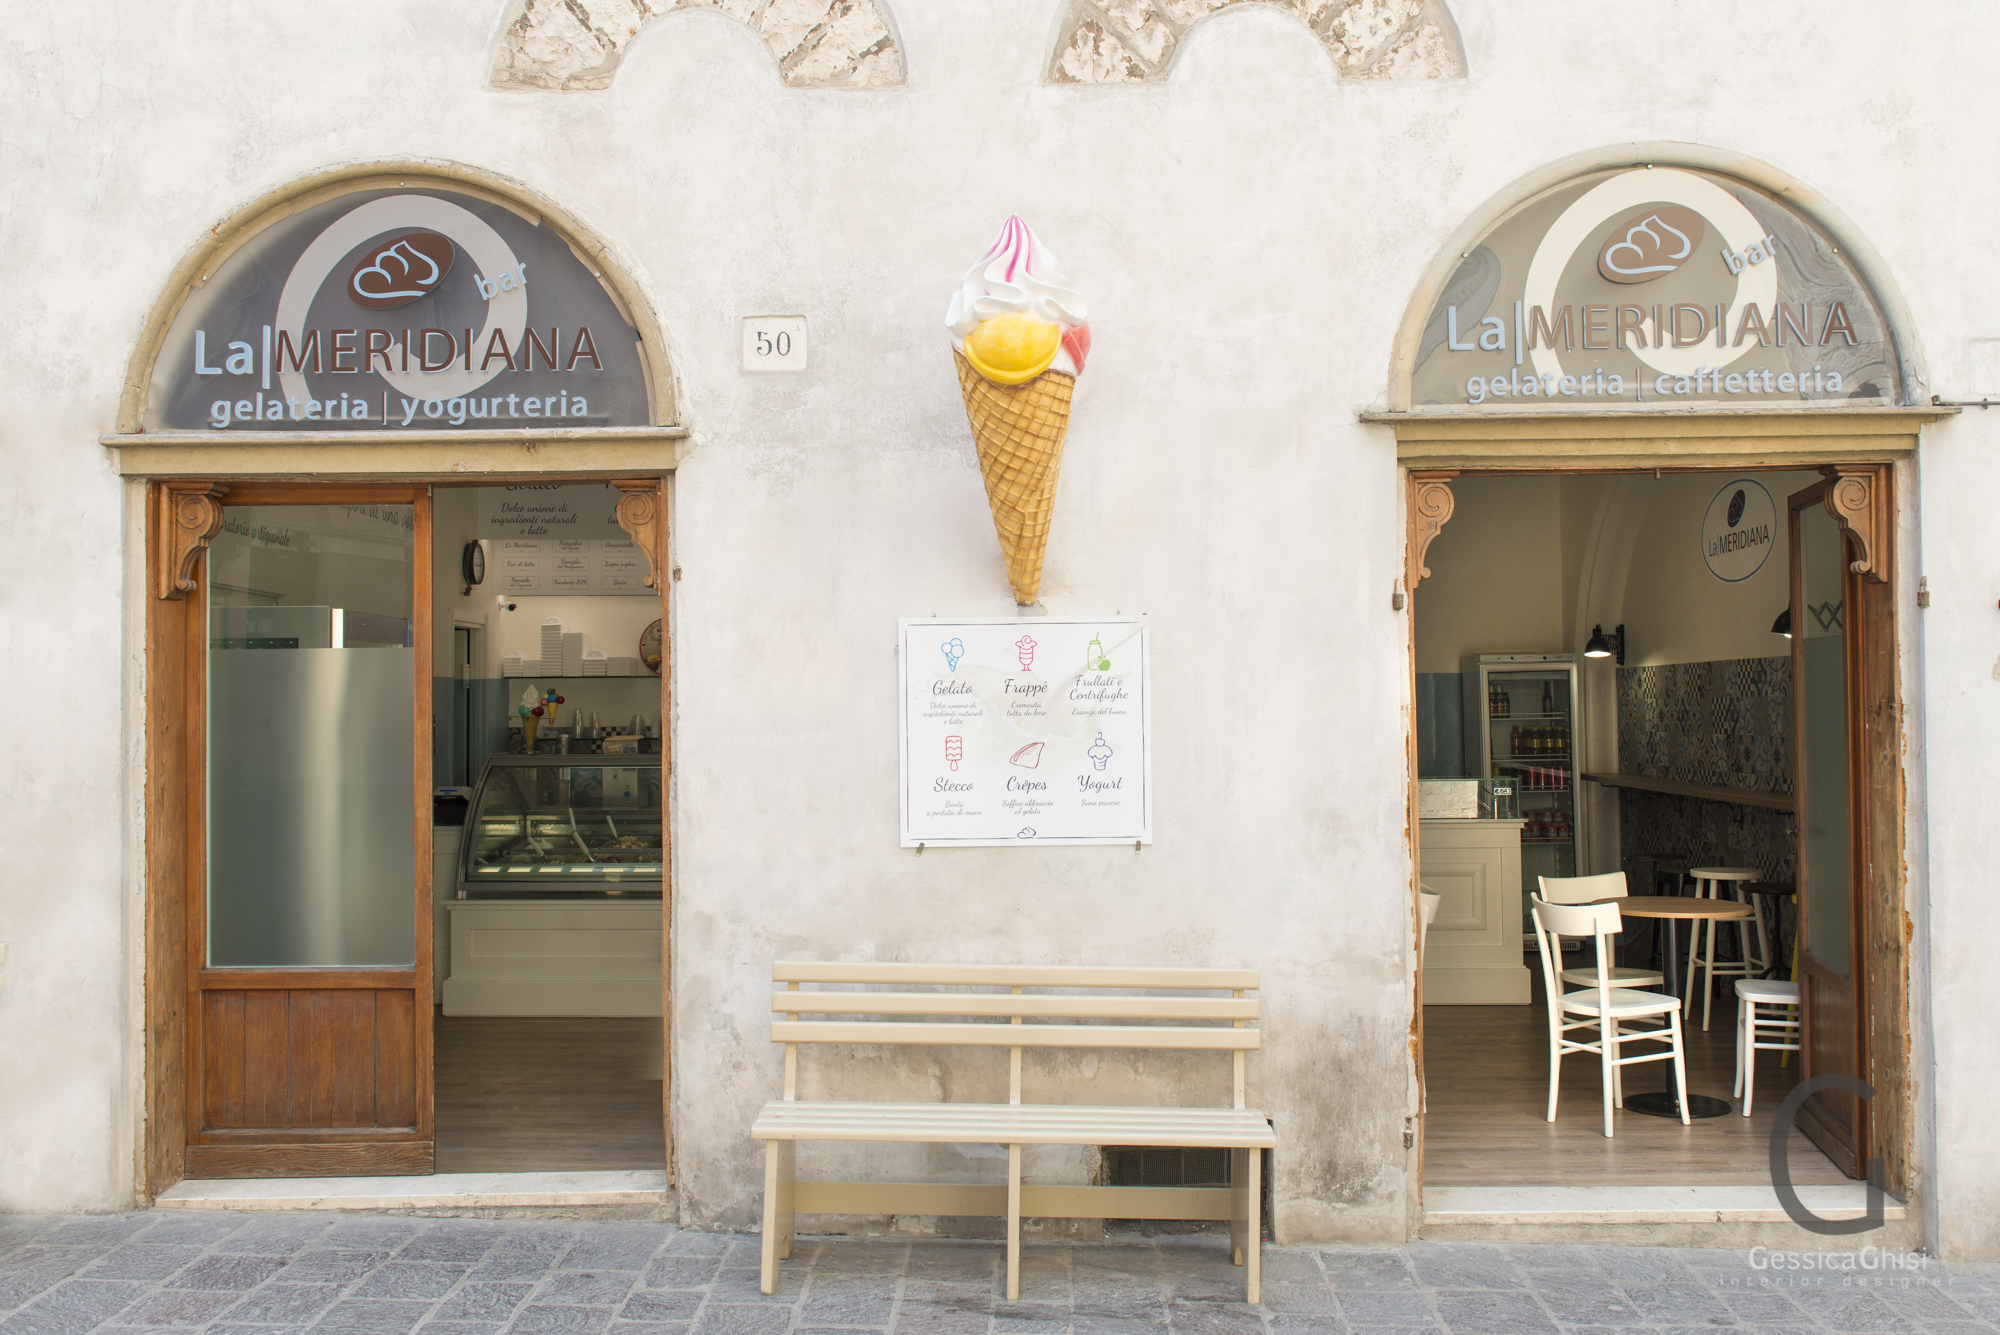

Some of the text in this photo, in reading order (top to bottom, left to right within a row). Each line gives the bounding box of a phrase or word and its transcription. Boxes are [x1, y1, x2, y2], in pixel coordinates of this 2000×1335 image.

[1720, 233, 1778, 276] bar
[473, 262, 527, 300] bar
[1447, 301, 1858, 351] La MERIDIANA
[195, 326, 603, 375] La MERIDIANA
[756, 331, 791, 356] 50
[1466, 364, 1843, 403] gelateria caffetteria
[211, 390, 589, 428] gelateria yogurteria
[501, 502, 569, 513] Dolce unione di
[491, 513, 578, 526] ingredienti naturali
[251, 525, 290, 548] artigianale
[527, 525, 548, 535] latte
[1708, 524, 1770, 557] La MERIDIANA
[932, 679, 974, 695] Gelato
[1004, 678, 1048, 697] Frappè
[1075, 674, 1115, 687] Frullati
[1069, 687, 1130, 702] Centrifughe
[929, 701, 946, 709] Dolce
[969, 701, 977, 709] di
[1072, 707, 1127, 717] Essenza del buono
[923, 709, 984, 719] ingredienti naturali
[948, 717, 963, 725] latte
[933, 776, 975, 793] Stecco
[1006, 775, 1048, 795] Crêpes
[1077, 774, 1124, 794] Yogurt
[944, 800, 964, 808] Bontà
[1002, 799, 1054, 808] Soffice abbraccio
[1080, 798, 1121, 808] Sano piacere
[931, 809, 955, 818] portata
[1014, 807, 1041, 816] al gelato
